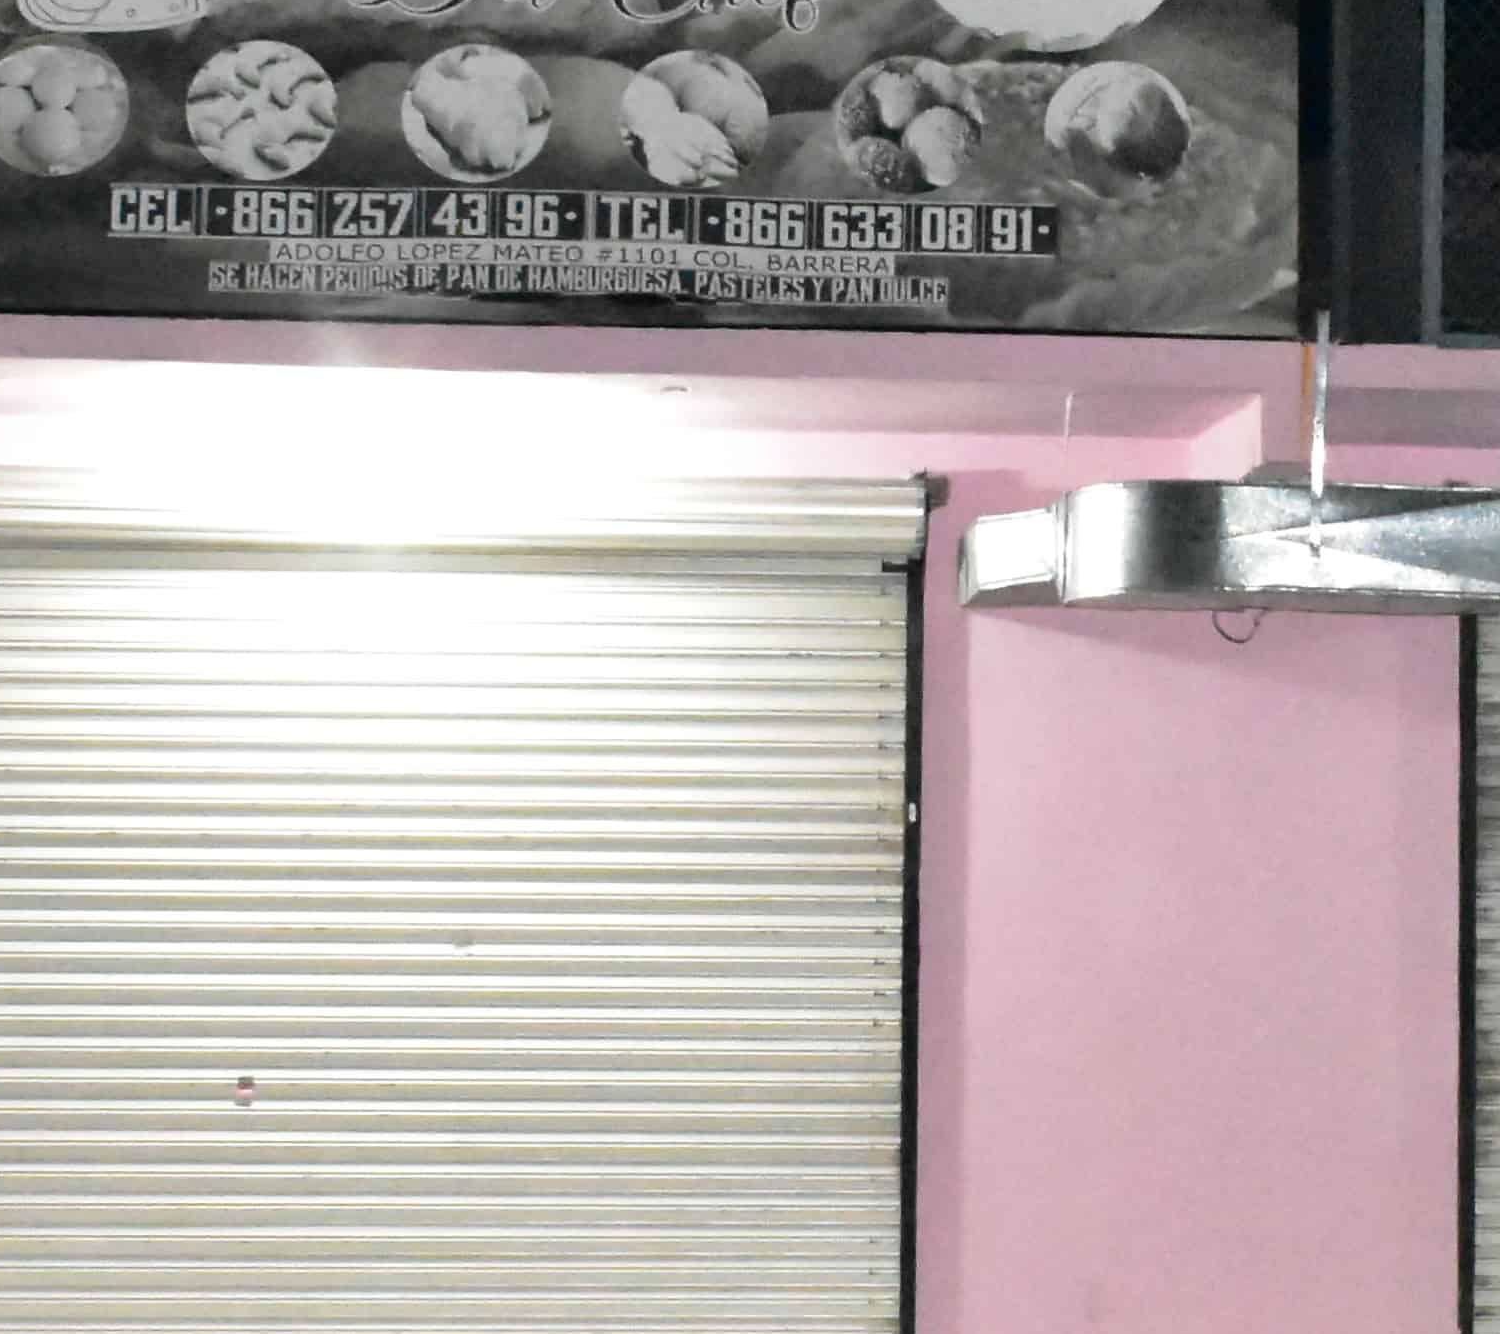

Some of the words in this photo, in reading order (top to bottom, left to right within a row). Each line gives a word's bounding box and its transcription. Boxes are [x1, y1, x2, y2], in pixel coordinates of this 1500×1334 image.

[109, 187, 191, 234] CEL
[231, 189, 317, 237] 866
[332, 191, 414, 238] 257
[431, 192, 488, 238] 43
[504, 193, 561, 239] 96
[600, 197, 685, 243] TEL
[724, 200, 806, 250] 866
[823, 203, 903, 252] 633
[920, 206, 974, 253] 08
[990, 208, 1033, 253] 91
[275, 243, 386, 263] ADOLFO
[398, 243, 483, 262] LOPEZ
[493, 244, 584, 263] MATEO
[767, 253, 891, 274] BARRERA
[445, 266, 490, 292] PAN
[694, 270, 805, 301] PASTELES
[812, 276, 827, 302] Y
[830, 276, 875, 304] PAN
